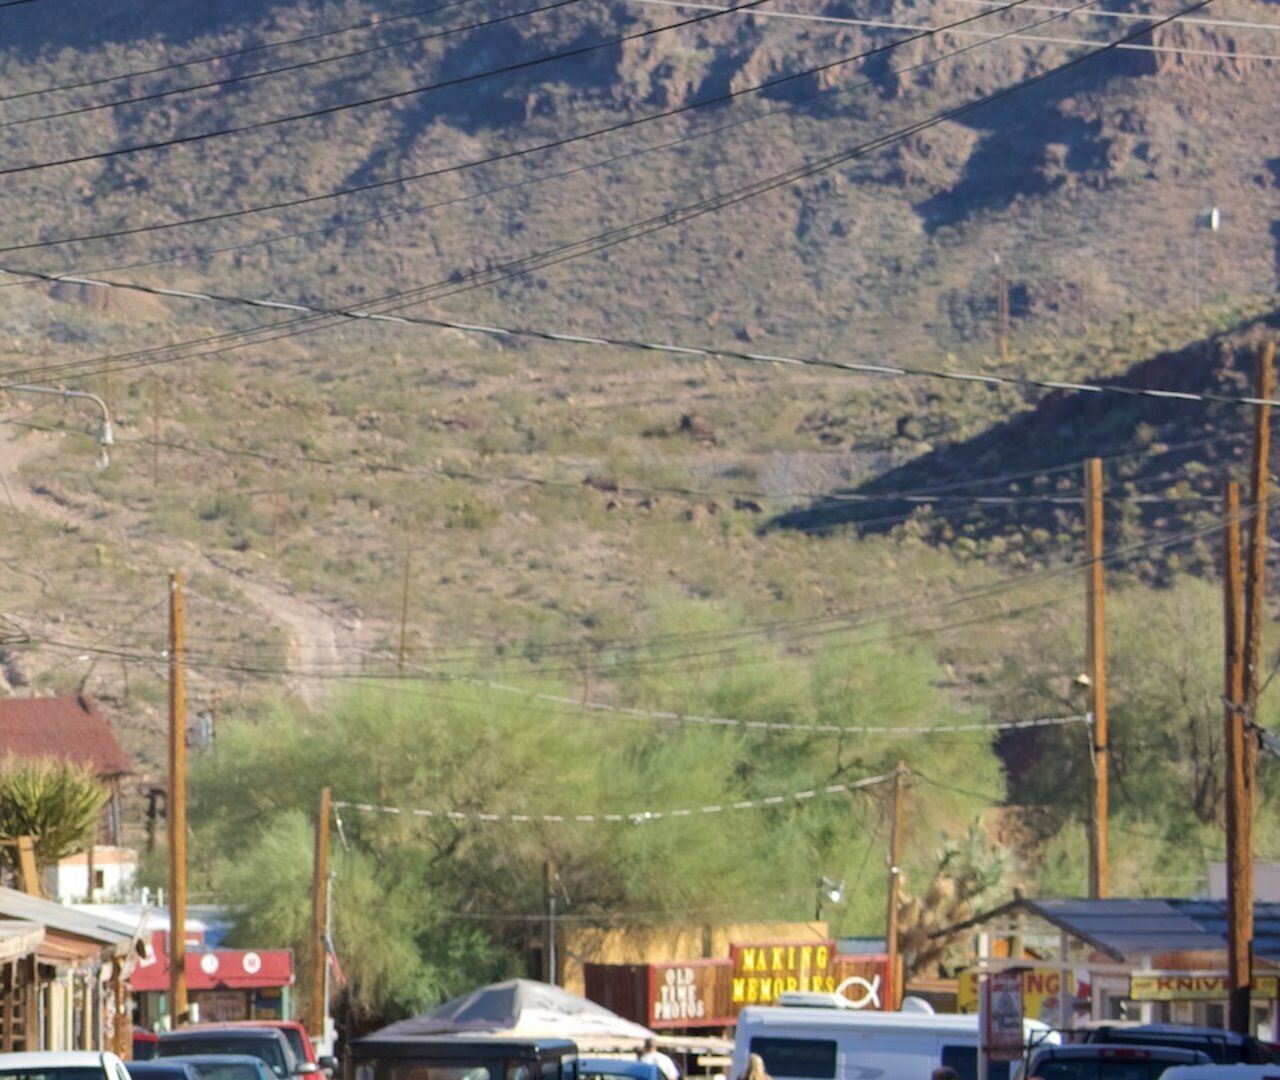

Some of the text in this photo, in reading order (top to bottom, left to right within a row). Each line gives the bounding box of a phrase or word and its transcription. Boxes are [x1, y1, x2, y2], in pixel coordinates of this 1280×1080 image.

[742, 945, 829, 972] MAKING
[666, 967, 695, 986] OLD
[660, 985, 697, 1004] TIME
[733, 976, 836, 1002] MEMORIES
[653, 1001, 706, 1021] PHOTOS
